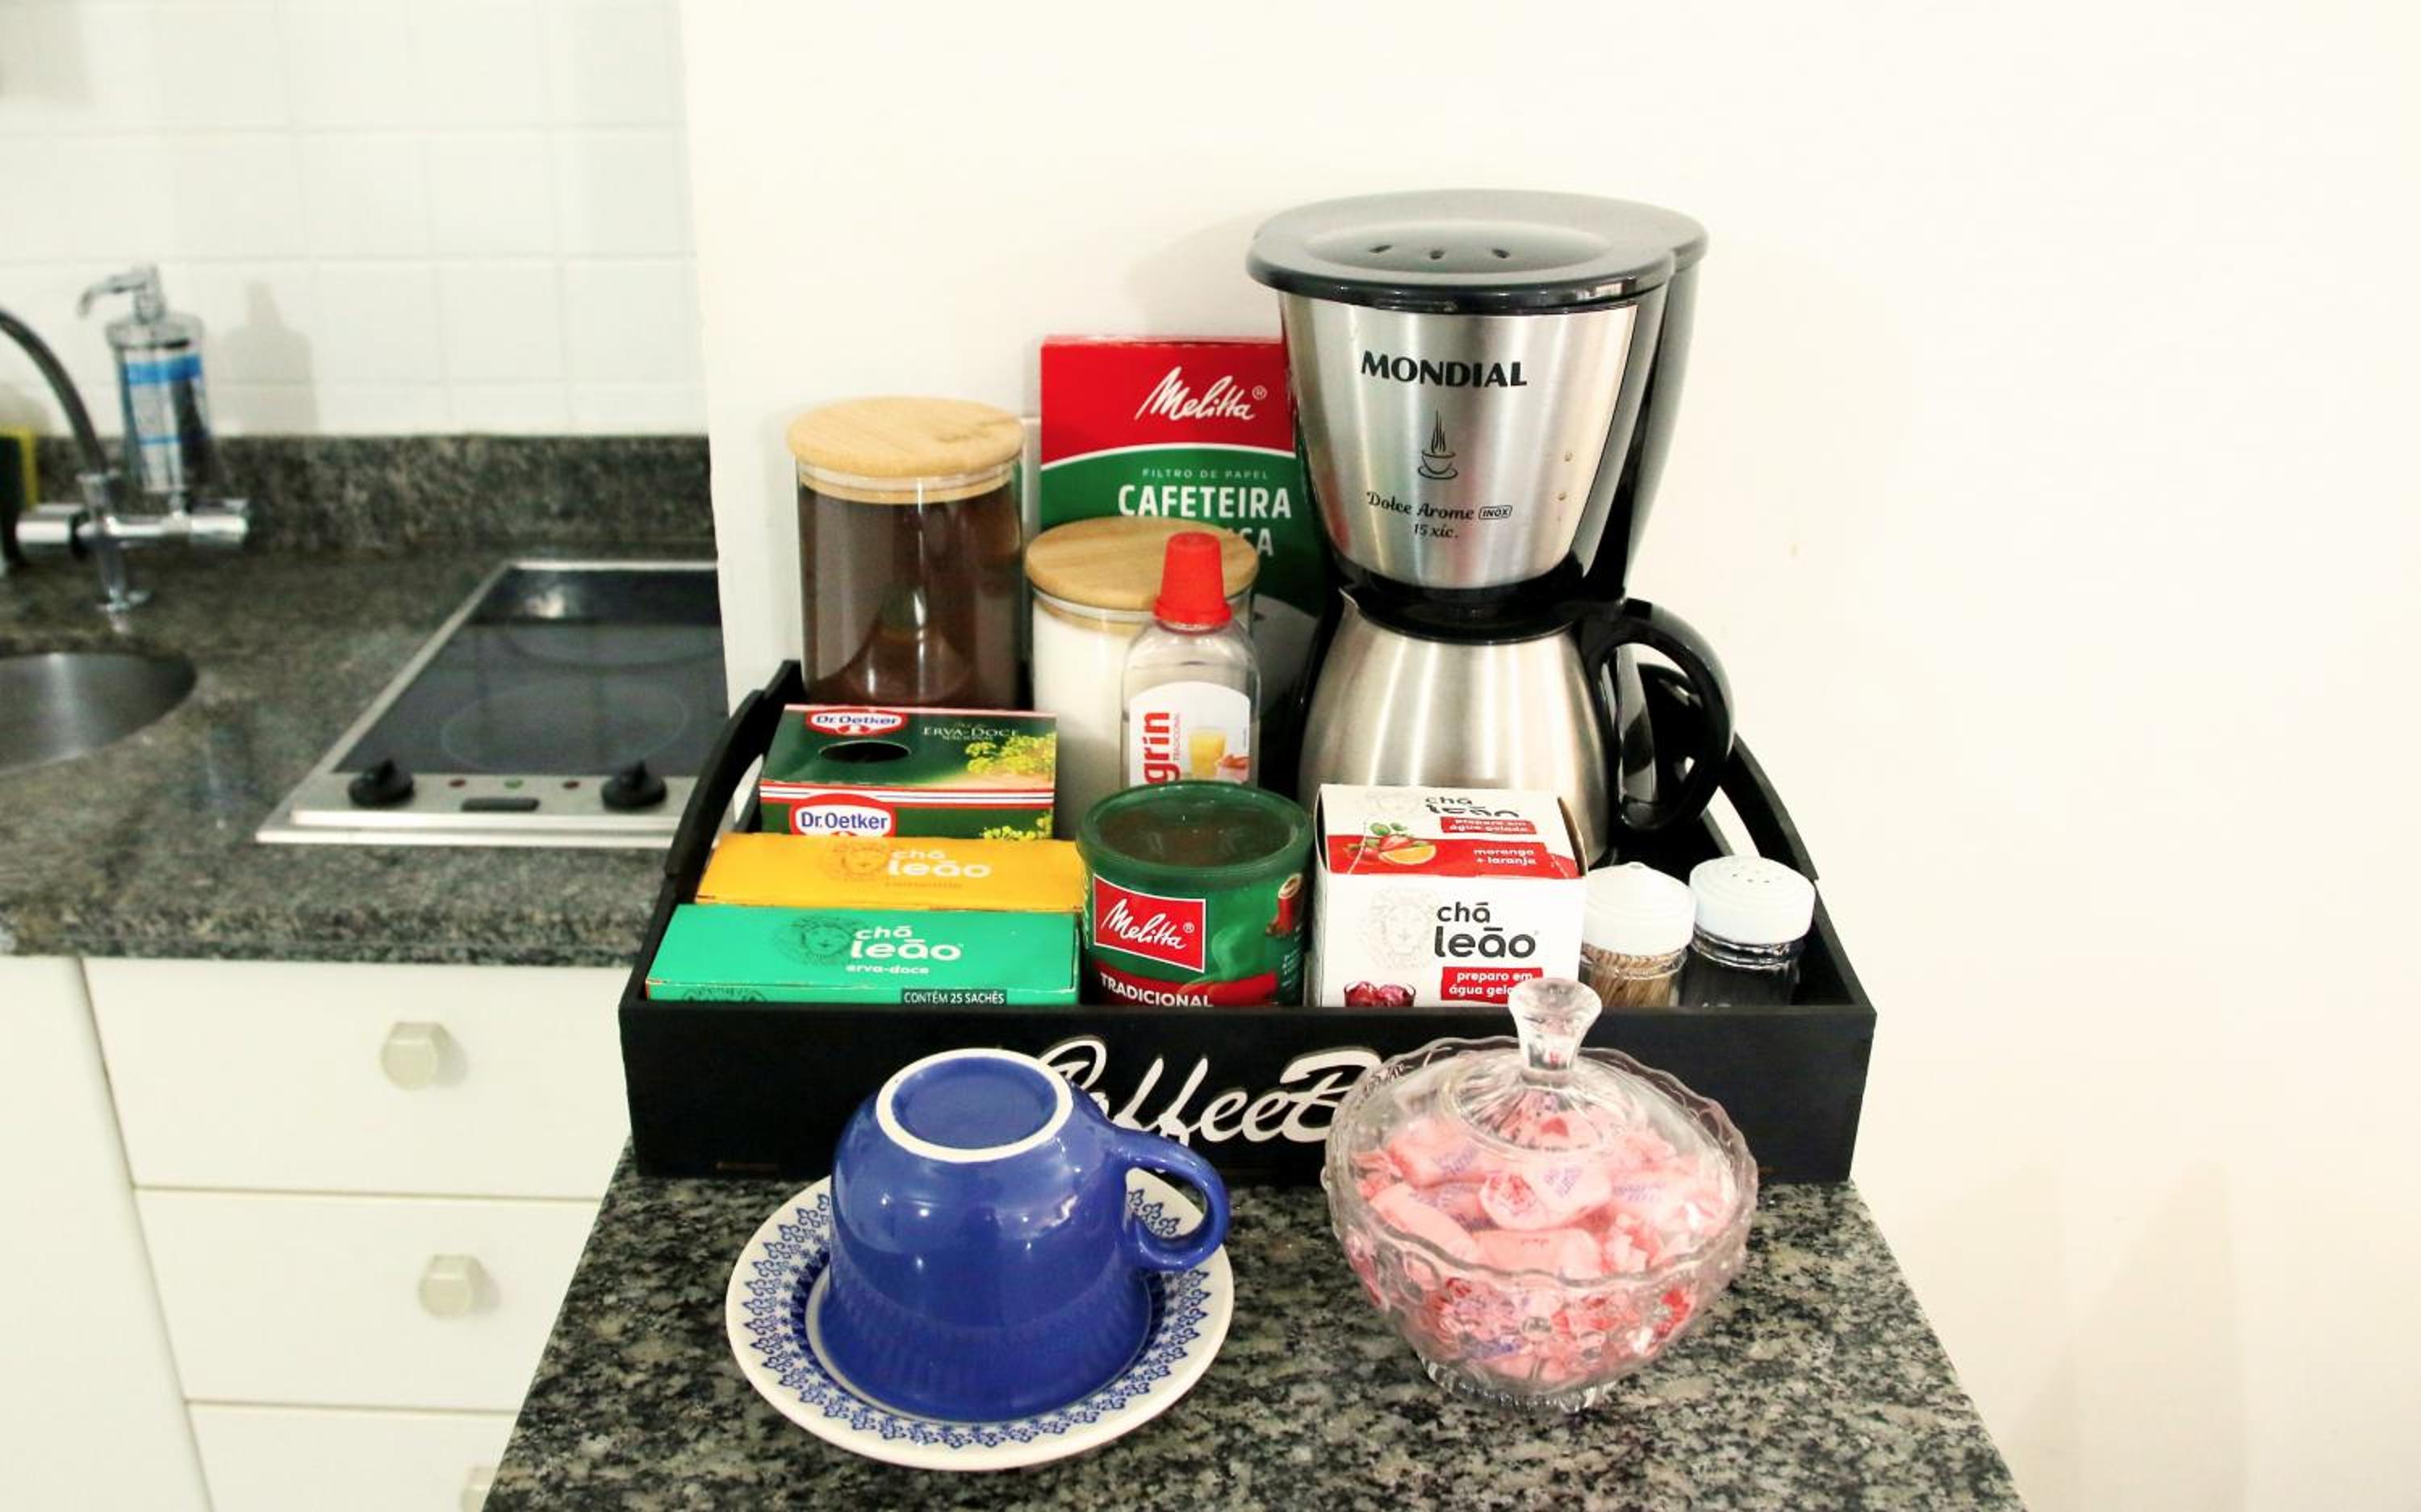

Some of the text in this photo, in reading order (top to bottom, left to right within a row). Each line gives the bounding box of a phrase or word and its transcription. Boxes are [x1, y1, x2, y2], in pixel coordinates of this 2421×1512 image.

[1361, 349, 1528, 387] MONDIAL
[1133, 365, 1256, 420] Melitta
[1142, 468, 1269, 479] FILTRO DE PAPEL
[1118, 484, 1292, 519] CAFETEIRA
[1366, 491, 1511, 520] Dolce Arome INOX
[1414, 524, 1428, 537] 15
[1143, 712, 1181, 784] grin
[1100, 898, 1187, 950] Melitta
[846, 964, 930, 975] erva-doce
[1457, 971, 1532, 984] preparo em
[903, 989, 948, 1004] CONTÉM
[950, 992, 963, 1004] 25
[1099, 971, 1214, 1007] TRADICIONAL
[1449, 984, 1512, 998] água gela
